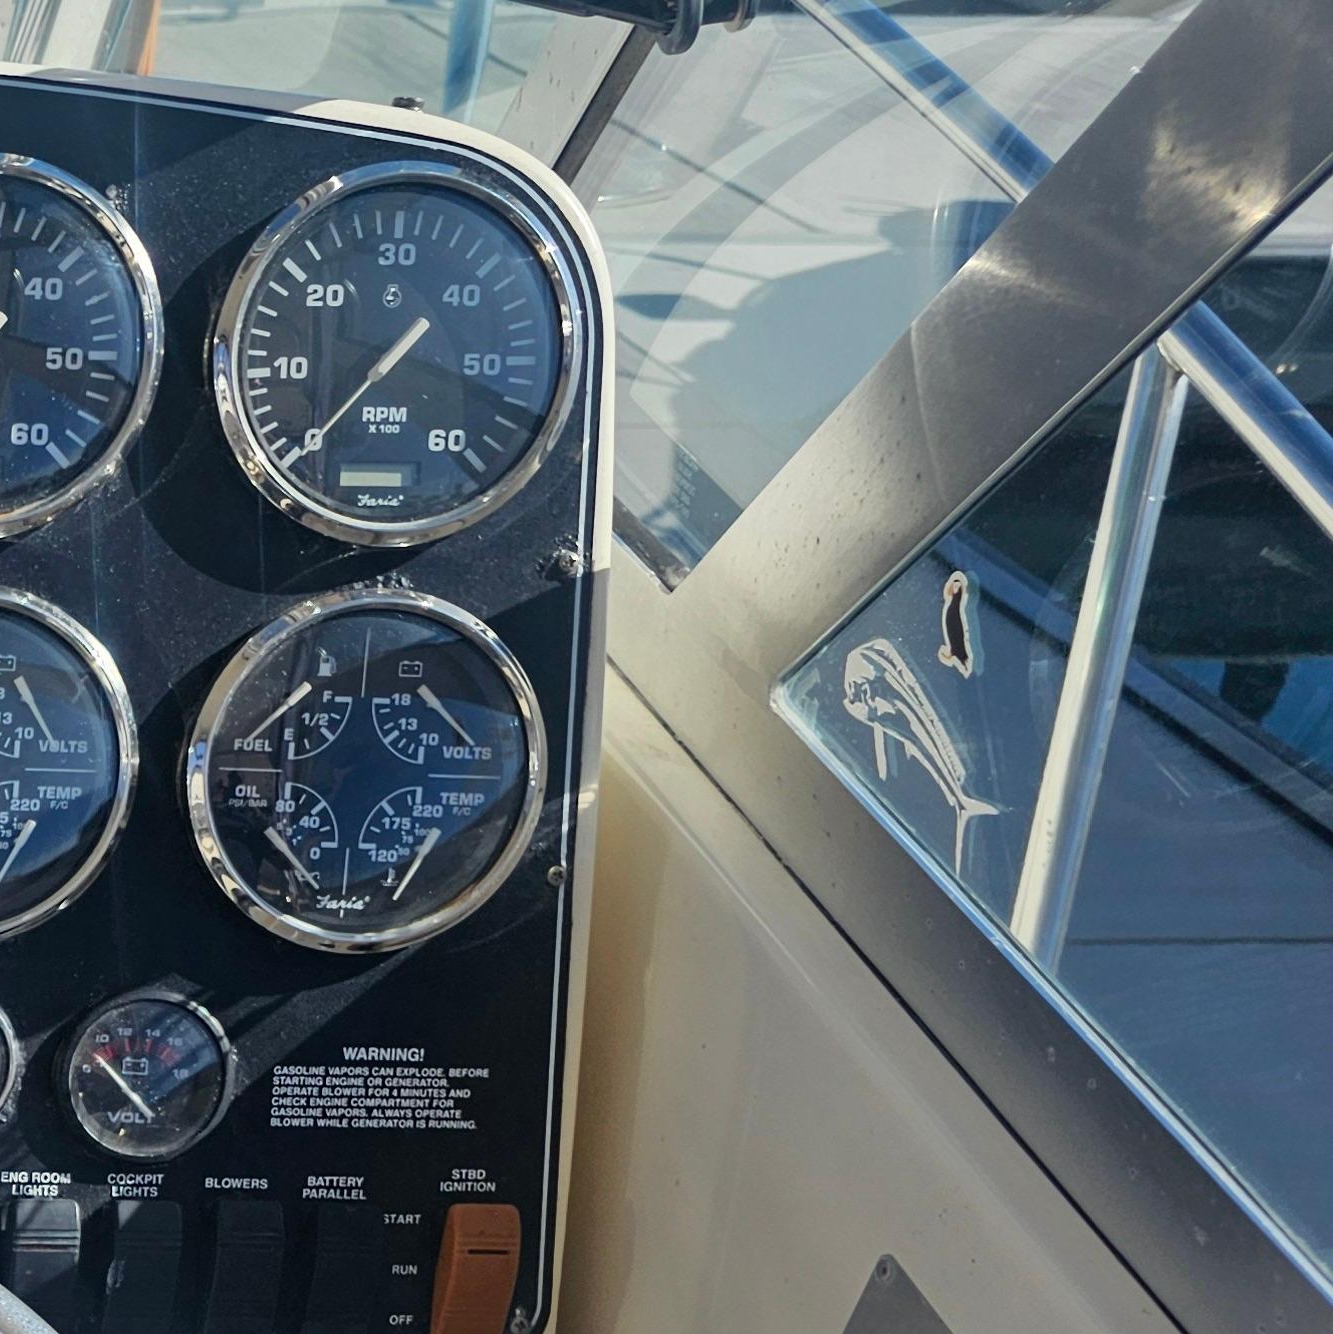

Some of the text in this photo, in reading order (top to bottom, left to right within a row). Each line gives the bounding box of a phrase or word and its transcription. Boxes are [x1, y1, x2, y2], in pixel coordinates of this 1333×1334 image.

[378, 243, 416, 266] 30
[24, 278, 63, 300] 40
[306, 284, 344, 307] 20
[443, 284, 480, 307] 40
[46, 348, 84, 371] 50
[463, 354, 501, 376] 50
[273, 357, 308, 379] 10
[362, 407, 407, 423] RPM
[11, 424, 48, 446] 60
[379, 424, 400, 434] 100
[428, 430, 466, 452] 60
[15, 727, 34, 739] 10
[39, 740, 88, 753] VOLTS
[234, 739, 272, 752] FUEL
[443, 746, 492, 759] VOLTS
[38, 786, 82, 799] TEMP
[235, 785, 260, 799] OIL
[10, 799, 40, 812] 220
[441, 793, 485, 805] TEMP
[343, 1047, 424, 1061] WARNING!
[274, 1066, 325, 1076] GASOLINE
[328, 1067, 369, 1076] VAPORS
[372, 1067, 394, 1076] CAN
[448, 1068, 489, 1078] BEFORE
[273, 1076, 323, 1086] STARTING
[326, 1077, 364, 1086] ENGINE
[367, 1078, 382, 1087] OR
[272, 1087, 470, 1098] OPERATE BLOWER FOR 4 MINUTES AND
[108, 1111, 154, 1124] VOLT
[0, 1171, 71, 1185] ENG ROOM
[107, 1174, 164, 1186] COCKPIT
[451, 1169, 486, 1180] STBD
[205, 1177, 268, 1190] BLOWERS
[307, 1176, 364, 1188] BATTERY
[440, 1181, 495, 1192] IGNITION
[11, 1184, 59, 1196] LIGHTS
[111, 1186, 158, 1198] LIGHTS
[302, 1188, 366, 1200] PARALLEL
[384, 1214, 421, 1225] START
[392, 1265, 417, 1275] RUN
[389, 1315, 413, 1326] OFF
